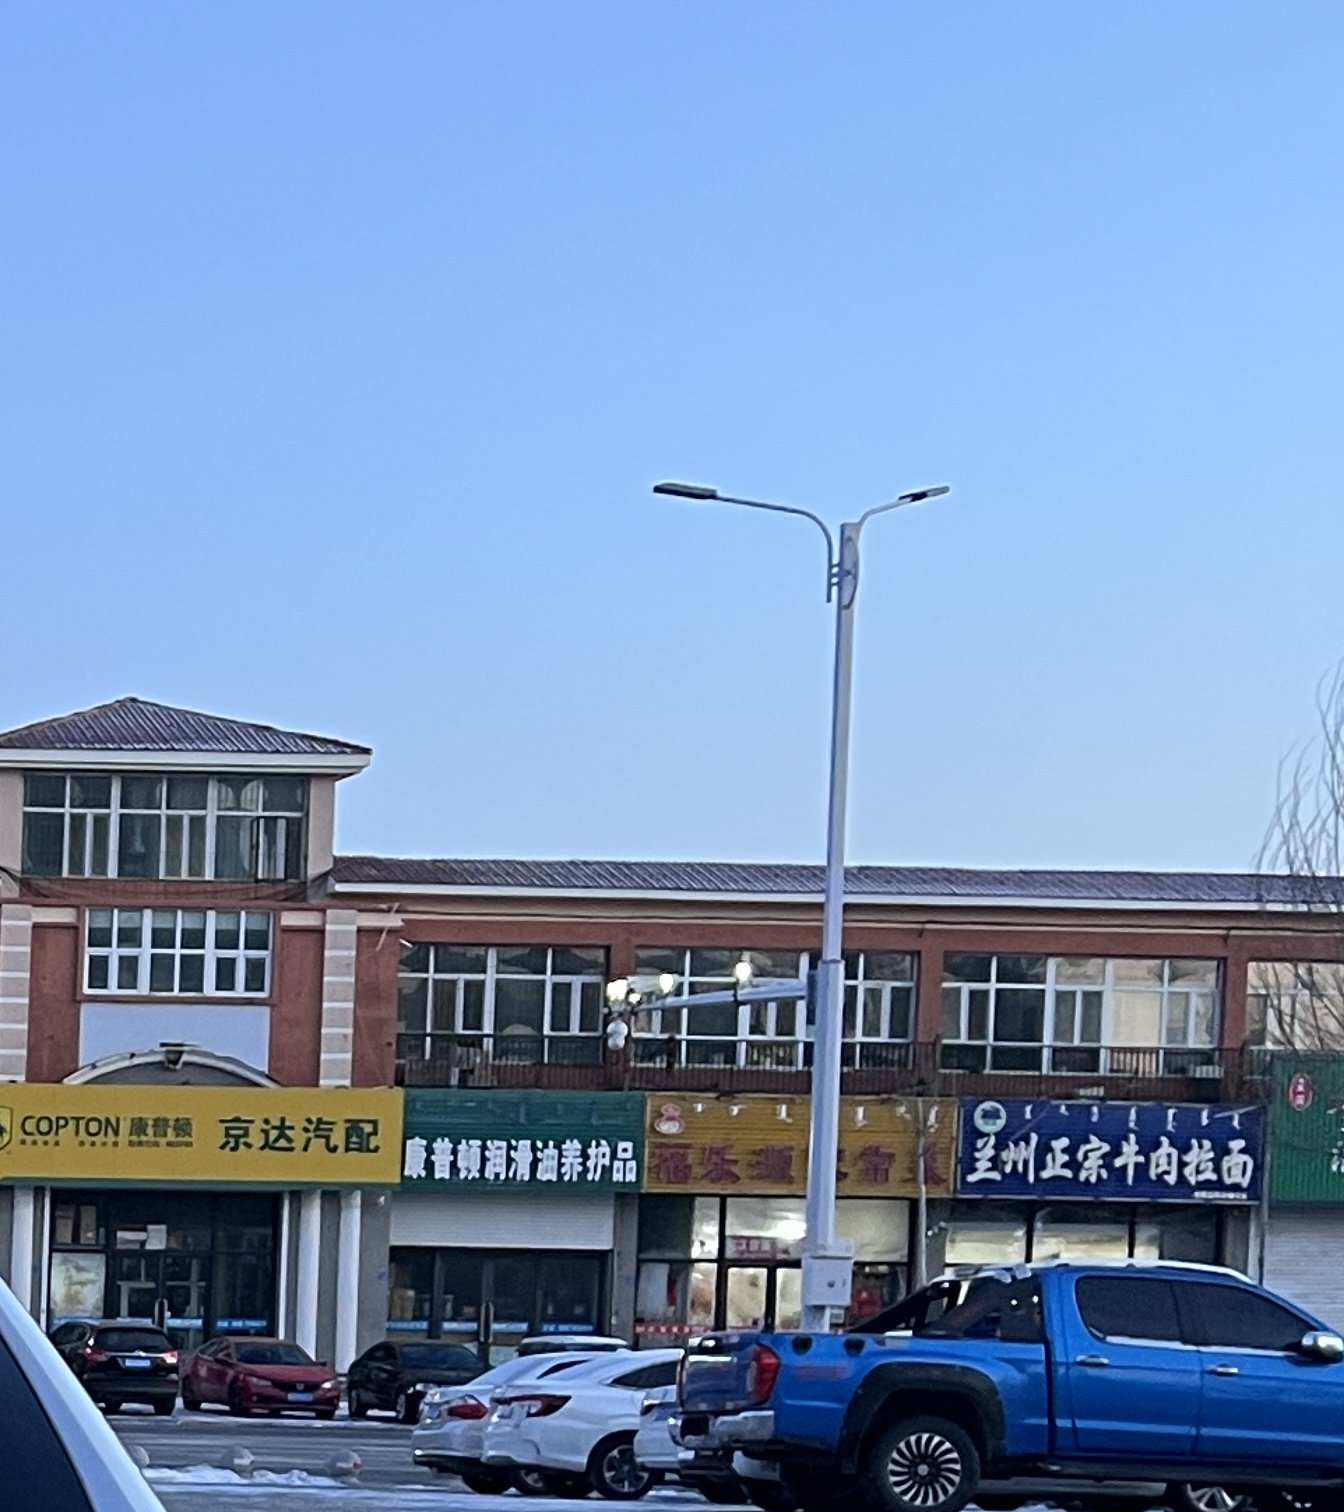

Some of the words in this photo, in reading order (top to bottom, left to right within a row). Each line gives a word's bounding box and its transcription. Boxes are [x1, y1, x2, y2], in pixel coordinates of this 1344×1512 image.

[20, 1115, 121, 1137] COPTON
[128, 1116, 193, 1138] 康普顿
[219, 1116, 381, 1154] 京达汽配
[404, 1137, 638, 1183] 康普顿润滑油养护品
[965, 1132, 1255, 1188] 兰州正宗牛肉拉面
